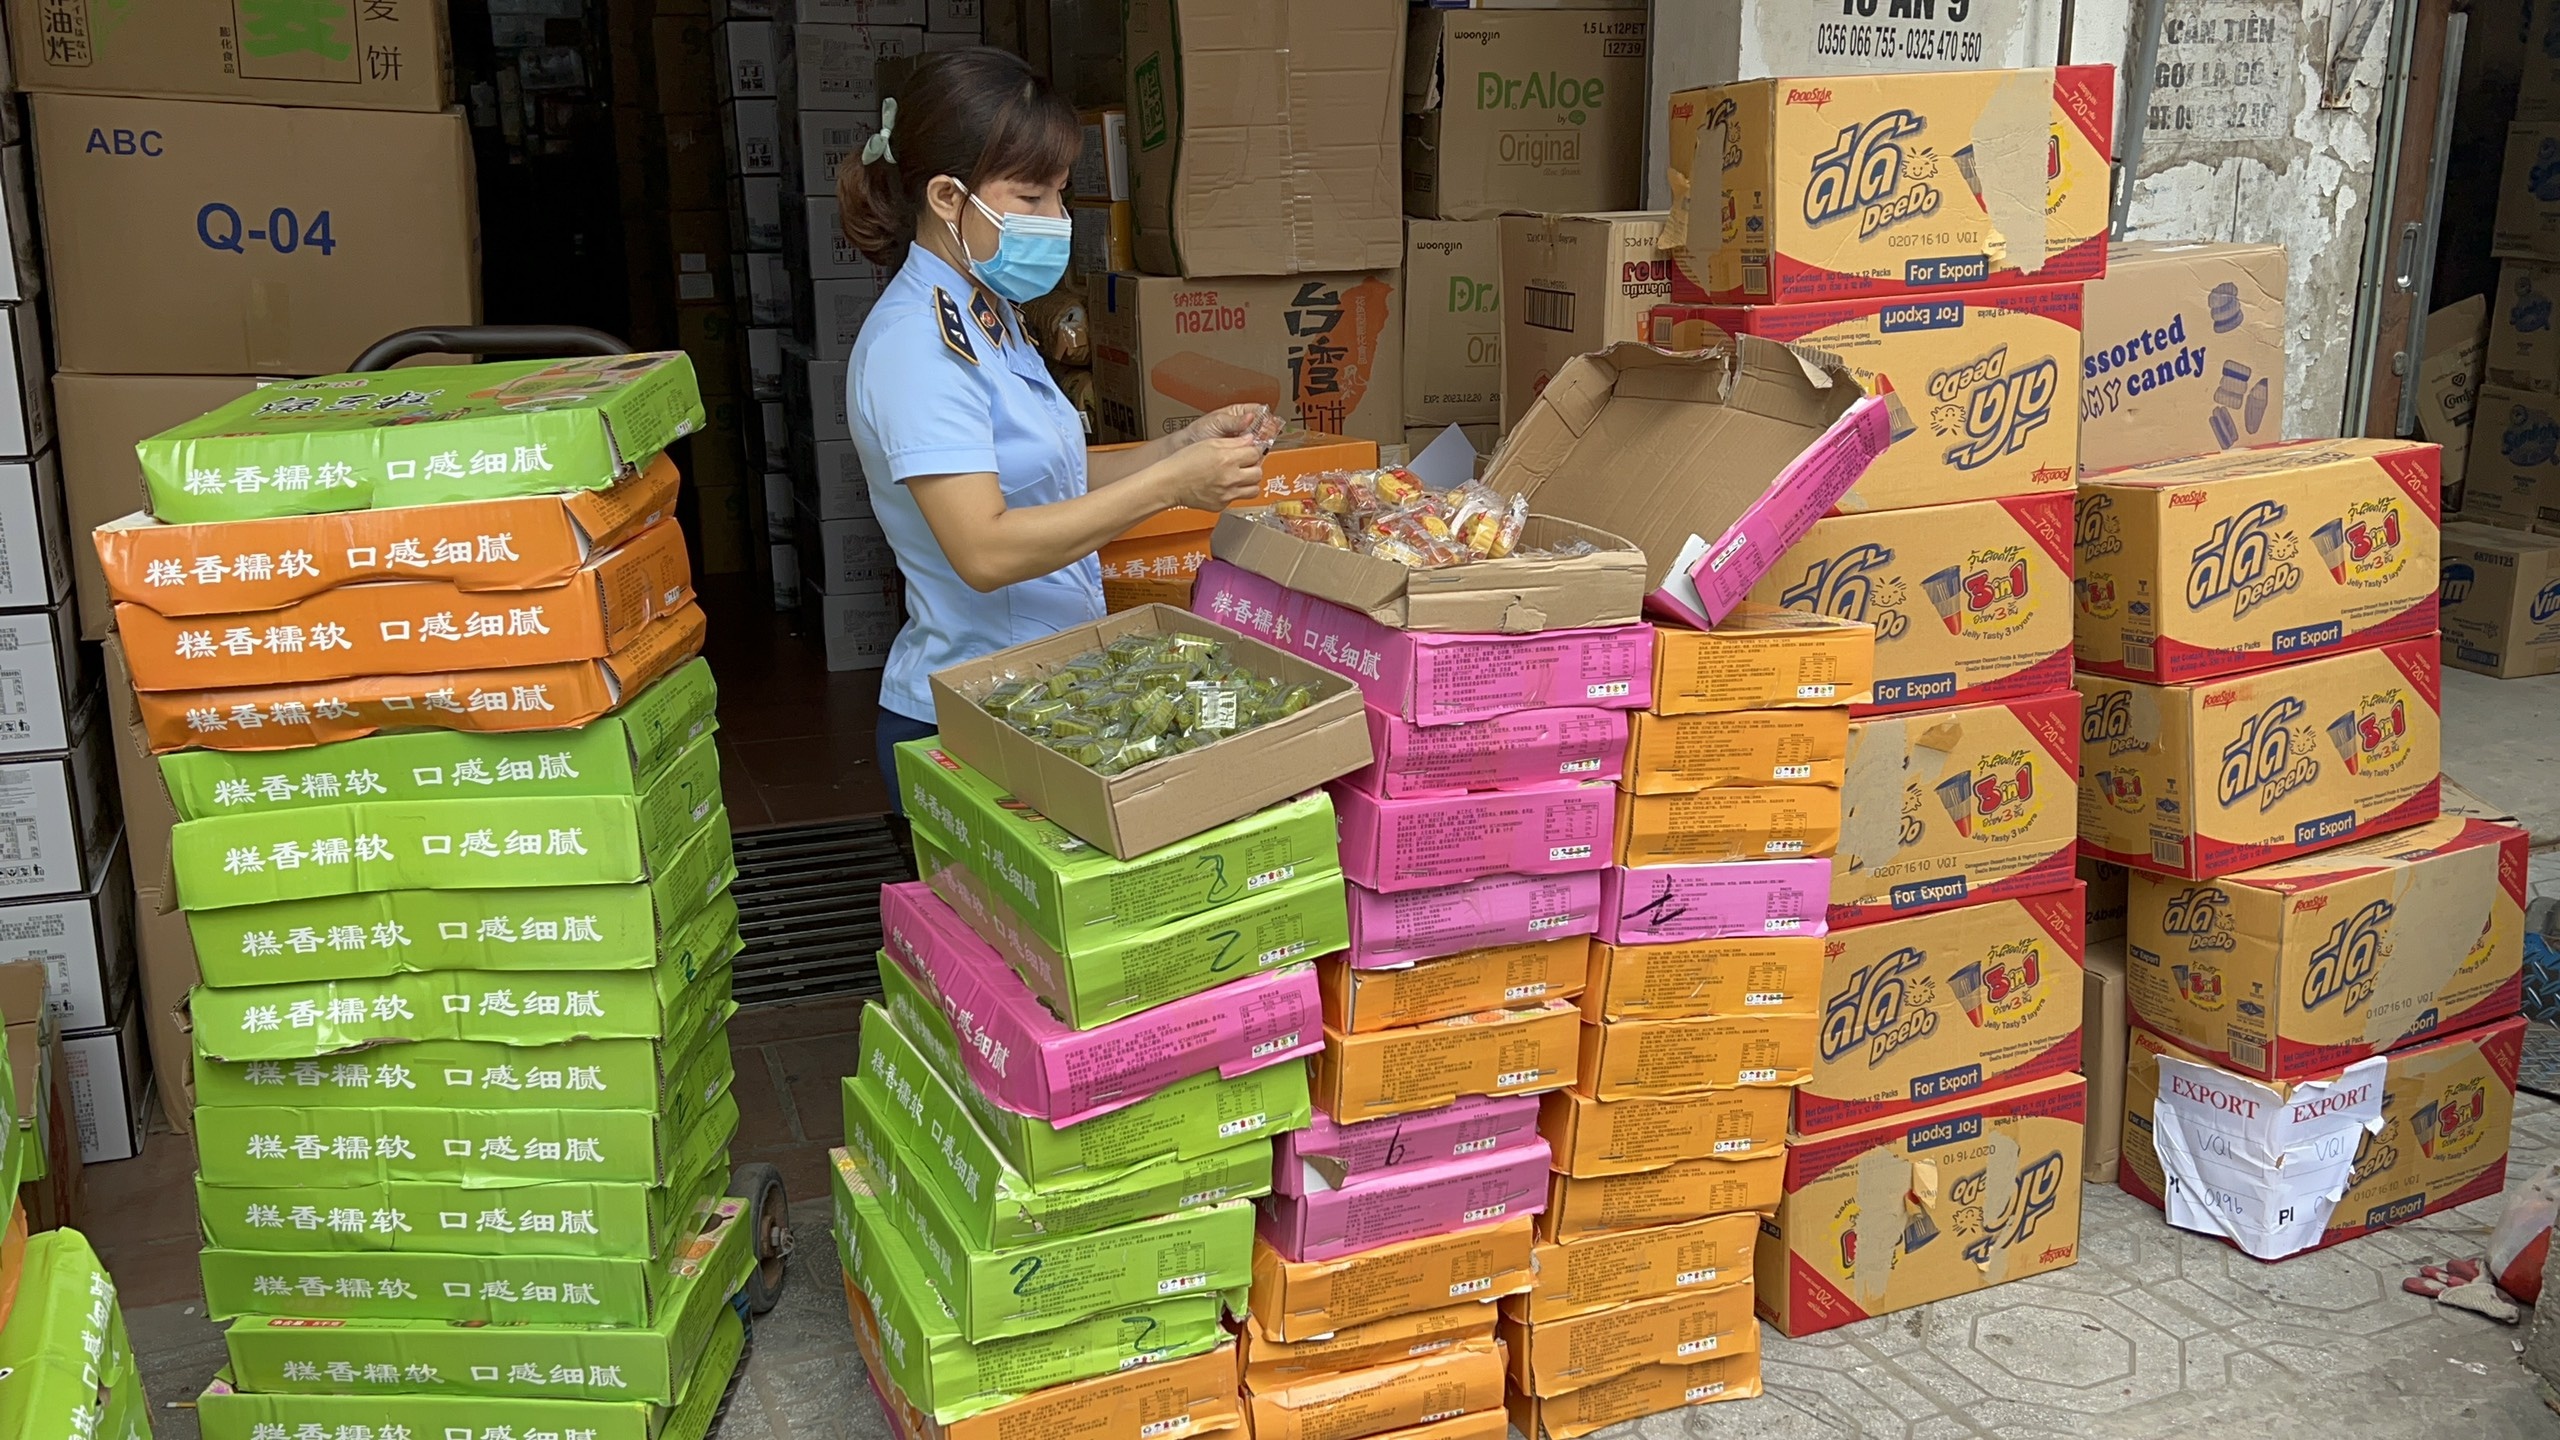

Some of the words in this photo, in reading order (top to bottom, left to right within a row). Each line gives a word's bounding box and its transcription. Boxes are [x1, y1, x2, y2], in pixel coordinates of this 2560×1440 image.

[1454, 30, 1500, 46] woongjin
[1607, 42, 1641, 55] 12739
[1818, 23, 1847, 55] 0356
[1850, 25, 1871, 56] 066
[1875, 27, 1896, 58] 755
[1906, 29, 1935, 60] 0325
[1937, 30, 1958, 61] 470
[1961, 32, 1982, 63] 560
[2068, 91, 2088, 117] 720
[1557, 113, 1567, 125] by
[85, 128, 164, 157] ABC
[1499, 132, 1581, 169] Original
[1858, 182, 1940, 241] DeeDo
[196, 202, 336, 256] Q-04
[1888, 232, 1949, 248] 02071610
[1957, 230, 1979, 244] VQI
[1416, 241, 1463, 256] woongjin
[1909, 264, 1933, 281] For
[1938, 260, 1985, 280] Export
[1175, 305, 1246, 334] naziba
[1884, 307, 1931, 328] Export
[1936, 306, 1959, 322] For
[2083, 313, 2186, 380] ssorted
[1930, 346, 2007, 402] DeeDo
[2127, 346, 2206, 397] candy
[183, 461, 357, 496] 糕香糯软
[386, 443, 554, 481] 口感细腻
[2403, 469, 2421, 493] 720
[2036, 518, 2055, 542] 720
[144, 549, 320, 587] 糕香糯软
[347, 532, 519, 570] 口感细腻
[2346, 577, 2362, 589] Jelly
[2363, 578, 2382, 589] Tasty
[2388, 558, 2407, 583] layers
[2232, 562, 2301, 621] DeeDo
[2441, 576, 2472, 602] im
[175, 622, 353, 660] 糕香糯软
[380, 606, 550, 643] 口感细腻
[1211, 589, 1292, 644] 糕香糯软
[1303, 629, 1381, 681] 口感细腻
[1962, 627, 1982, 641] Jelly
[1983, 629, 2005, 642] Tasty
[2012, 611, 2035, 634] layers
[2275, 634, 2297, 651] For
[2300, 625, 2340, 648] Export
[2408, 662, 2424, 682] 720
[1878, 686, 1901, 700] For
[1906, 678, 1952, 698] Export
[187, 697, 359, 734] 糕香糯软
[382, 684, 555, 715] 口感细腻
[2040, 722, 2058, 744] 720
[214, 769, 387, 807] 糕香糯软
[413, 751, 580, 787] 口感细腻
[2260, 755, 2318, 813] DeeDo
[1972, 832, 1989, 844] Jelly
[1990, 833, 2010, 843] Tasty
[2017, 813, 2038, 837] layers
[2298, 825, 2317, 842] For
[2319, 816, 2353, 840] Export
[224, 834, 394, 875] 糕香糯软
[422, 827, 588, 858] 口感细腻
[1874, 859, 1931, 879] 02071610
[1937, 857, 1957, 870] VQI
[1894, 890, 1916, 905] For
[1920, 881, 1963, 902] Export
[2047, 910, 2065, 931] 720
[242, 919, 411, 957] 糕香糯软
[438, 915, 604, 943] 口感细腻
[2189, 932, 2237, 952] DeeDo
[2458, 964, 2474, 977] Tasty
[241, 993, 414, 1034] 糕香糯软
[442, 990, 605, 1017] 口感细腻
[2366, 999, 2413, 1020] 01071610
[2417, 991, 2434, 1007] VQI
[943, 994, 1010, 1079] 口感细腻
[1868, 1007, 1937, 1071] DeeDo
[244, 1061, 416, 1090] 糕香糯软
[443, 1064, 607, 1092] 口感细腻
[1914, 1080, 1935, 1096] For
[1939, 1070, 1979, 1094] Export
[2172, 1075, 2260, 1120] EXPORT
[2292, 1083, 2373, 1124] EXPORT
[871, 1047, 923, 1127] 糕香糯软
[930, 1117, 981, 1203] 口感细腻
[1912, 1122, 1953, 1147] Export
[1957, 1118, 1978, 1134] For
[246, 1133, 416, 1160] 糕香糯软
[443, 1136, 605, 1164] 口感细腻
[2353, 1180, 2400, 1203] 01071610
[2404, 1172, 2420, 1188] VQI
[246, 1202, 412, 1234] 糕香糯软
[438, 1207, 599, 1235] 口感细腻
[2279, 1206, 2294, 1225] PI
[2368, 1209, 2386, 1225] For
[2389, 1199, 2423, 1220] Export
[253, 1275, 417, 1300] 糕香糯软
[442, 1279, 600, 1306] 口感细腻
[1815, 1288, 1836, 1309] 720
[283, 1360, 445, 1384] 糕香糯软
[470, 1361, 628, 1389] 口感细腻
